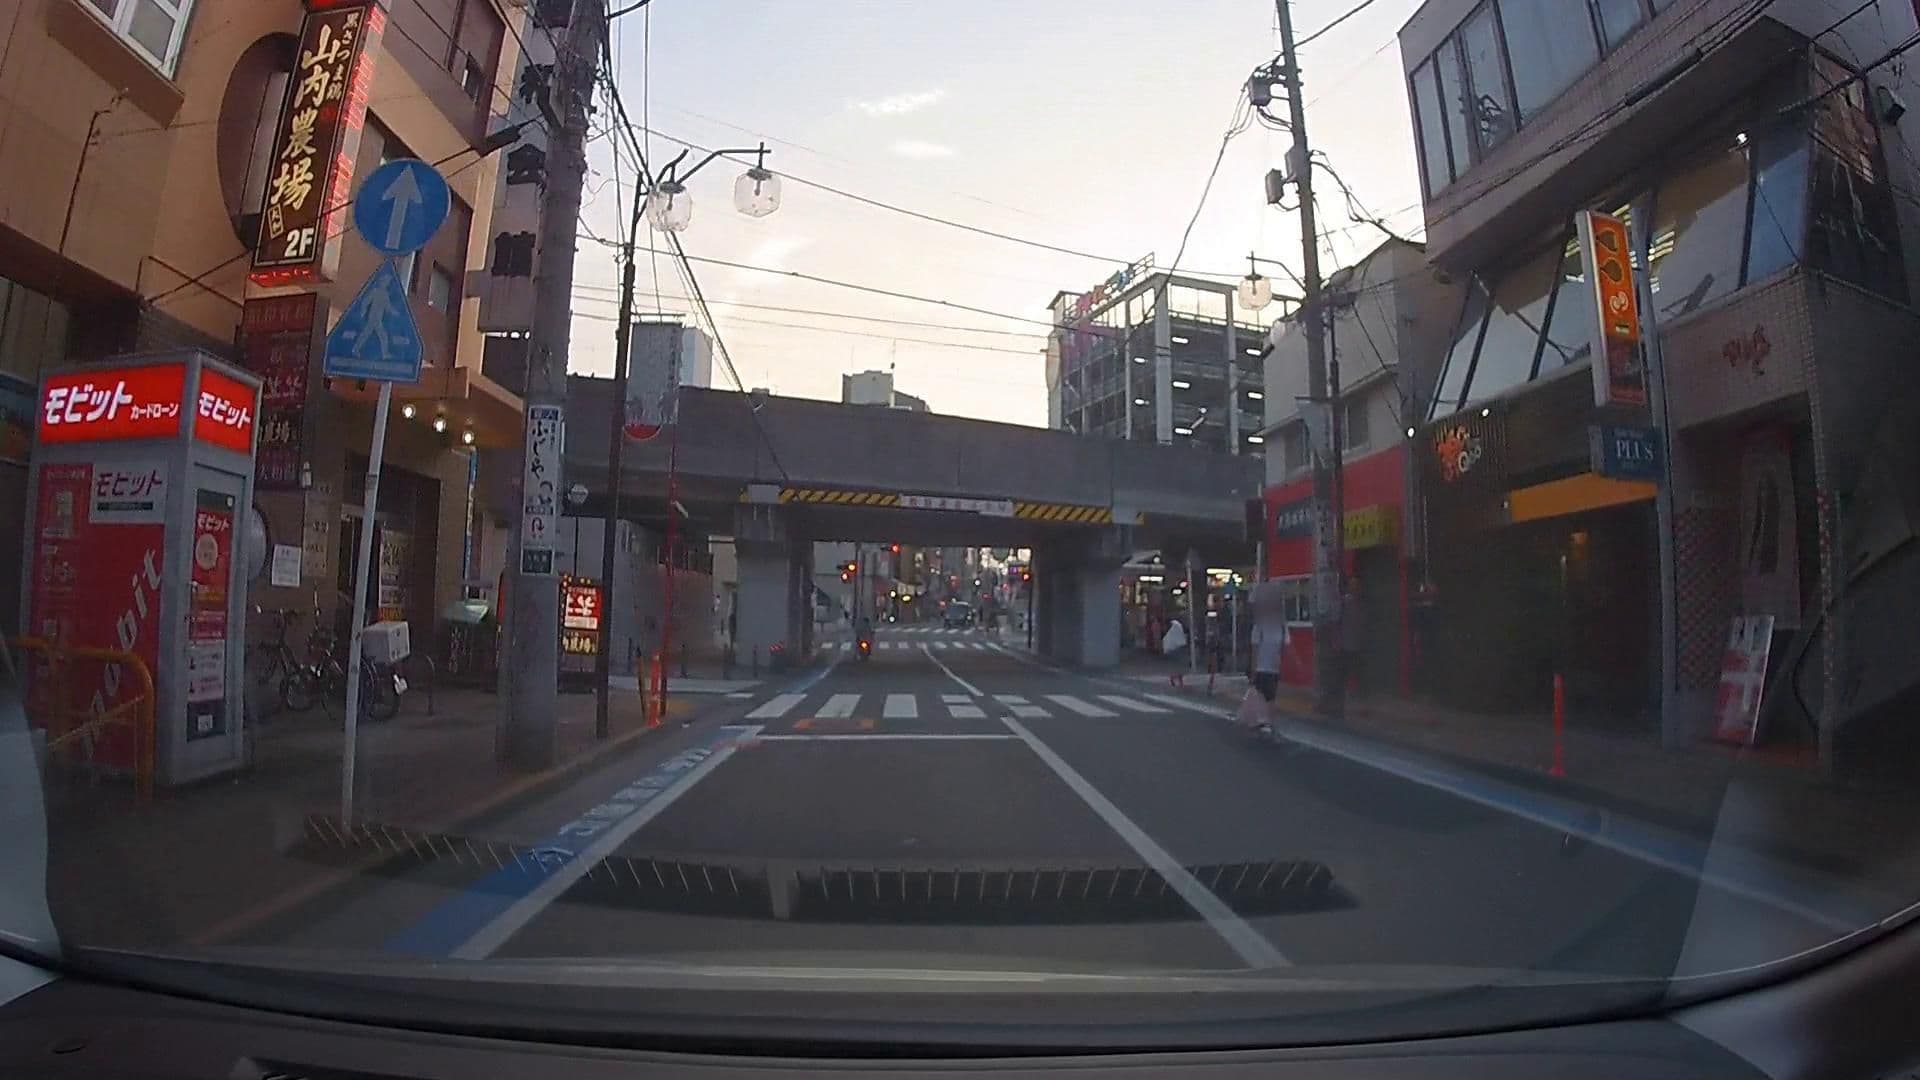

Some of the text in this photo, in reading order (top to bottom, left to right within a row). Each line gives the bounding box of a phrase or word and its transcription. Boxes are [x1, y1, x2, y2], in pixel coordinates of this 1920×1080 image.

[270, 24, 341, 211] 山内農場
[284, 227, 315, 258] 2F
[45, 381, 133, 425] モビット
[130, 402, 179, 421] カードローン
[199, 391, 251, 430] モビット
